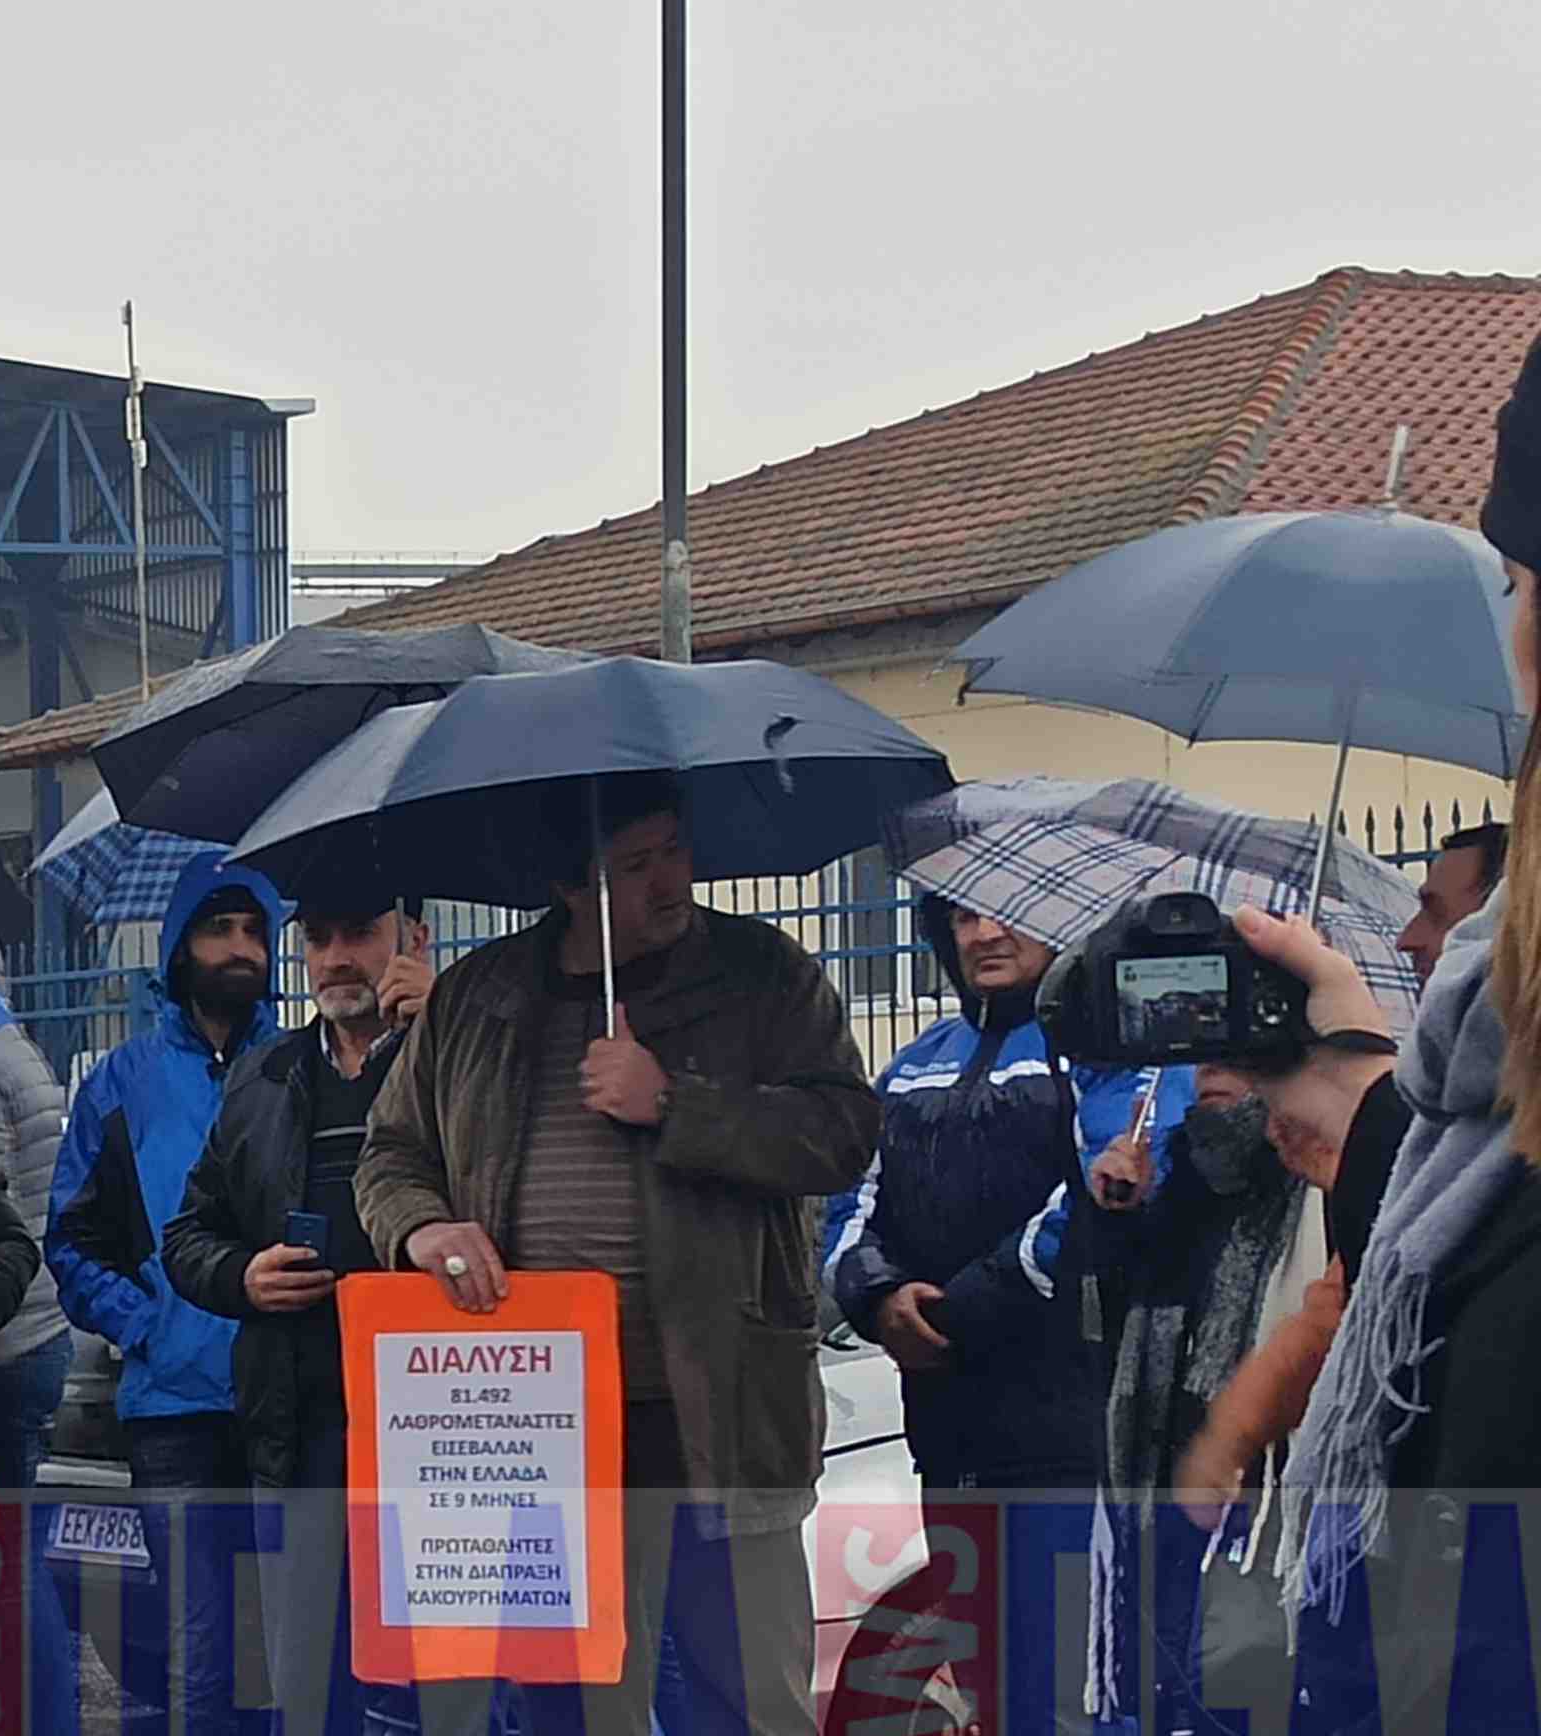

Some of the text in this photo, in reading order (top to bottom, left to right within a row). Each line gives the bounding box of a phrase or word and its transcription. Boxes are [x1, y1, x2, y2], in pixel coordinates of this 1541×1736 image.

[406, 1345, 553, 1374] ΔΙΑΛΥΣΗ
[450, 1388, 512, 1404] 81.492
[388, 1413, 577, 1430] ΛΑΘΡΟΜΕΤΑΝΑΣΤΕΣ
[431, 1440, 534, 1456] ΕΙΣΕΒΑΛΑΝ
[418, 1466, 548, 1482] ΣΤΗΝ ΕΛΛΑΔΑ
[429, 1492, 539, 1508] ΣΕ 9 ΜΗΝΕΣ
[420, 1538, 554, 1554] ΠΡΩΤΑΘΛΗΤΕΣ
[415, 1564, 561, 1580] ΣΤΗΝ ΔΙΑΠΡΑΞΗ
[406, 1589, 572, 1606] ΚΑΚΟΥΡΓΗΜΑΤΩΝ
